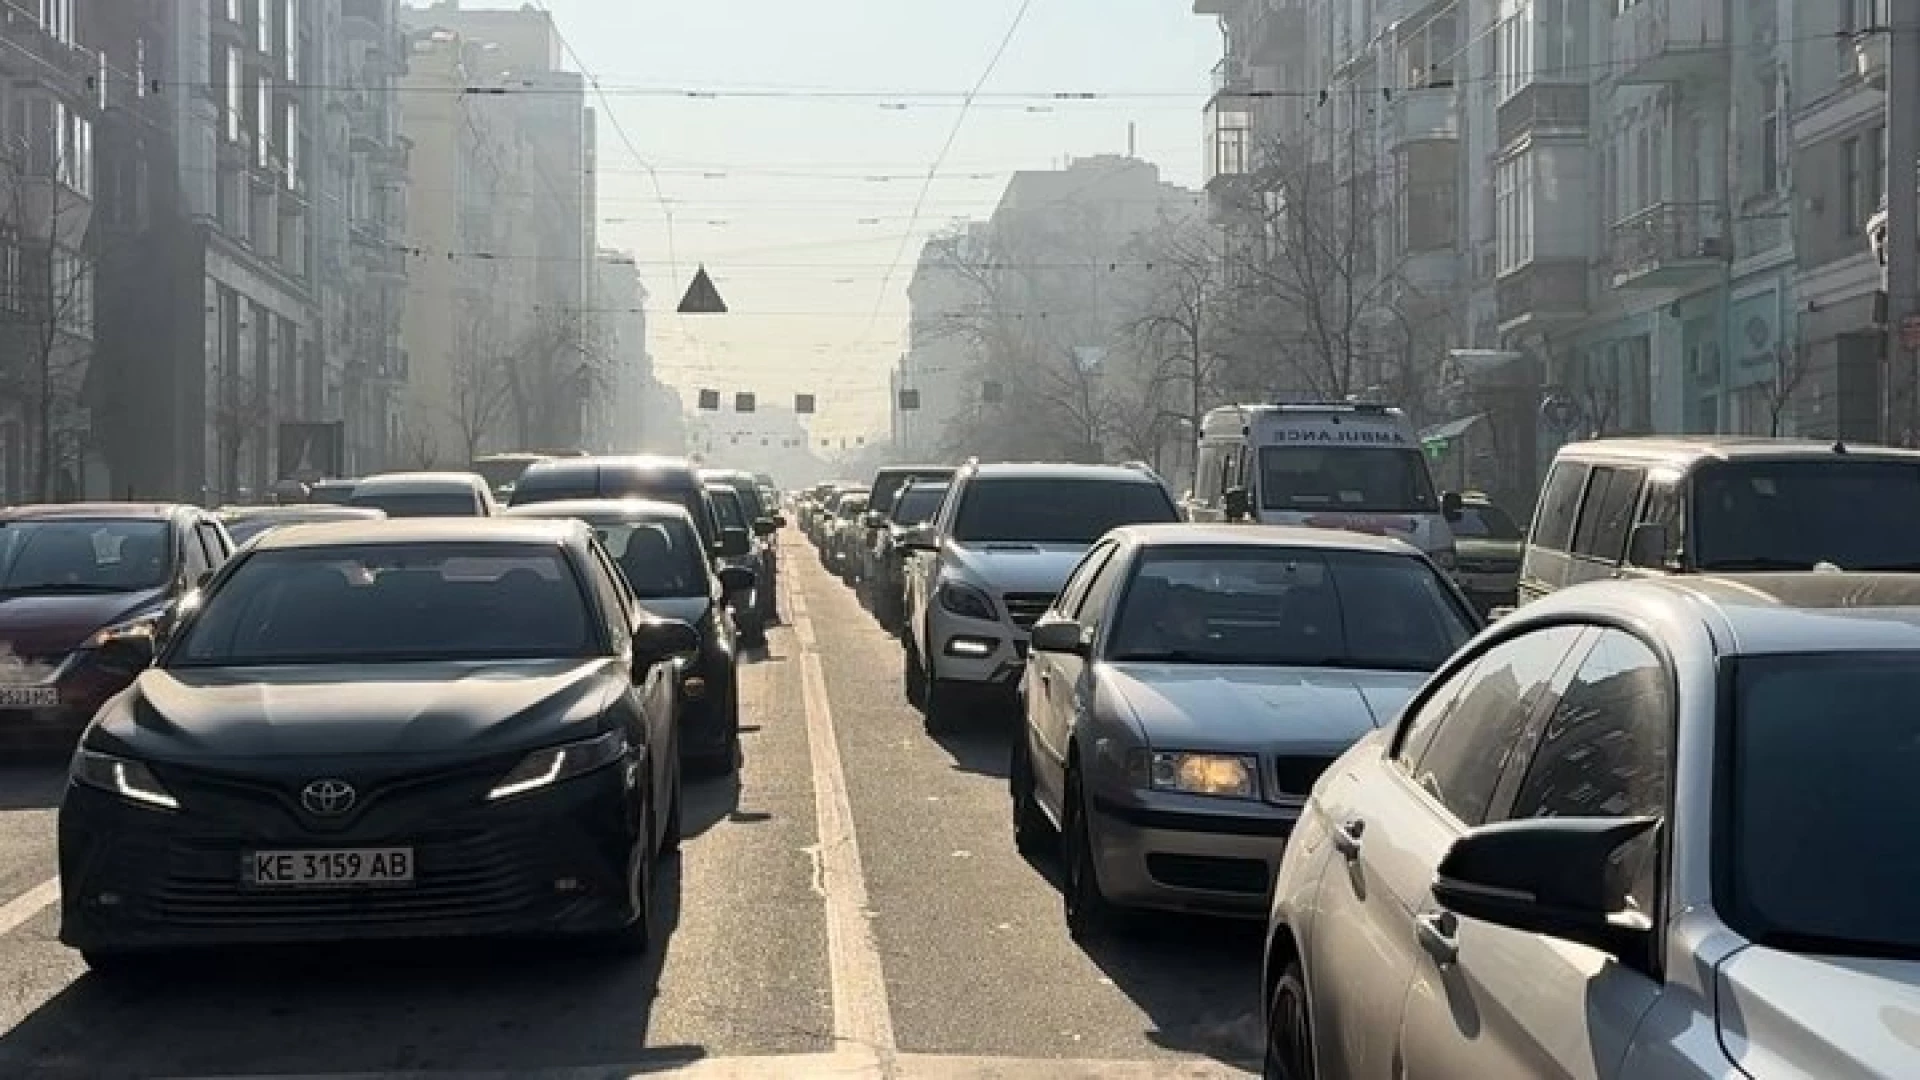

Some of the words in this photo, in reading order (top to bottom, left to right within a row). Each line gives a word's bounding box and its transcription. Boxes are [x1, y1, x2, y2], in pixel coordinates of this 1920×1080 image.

[257, 855, 296, 881] KE
[303, 853, 361, 879] 3159
[370, 853, 406, 878] AB
